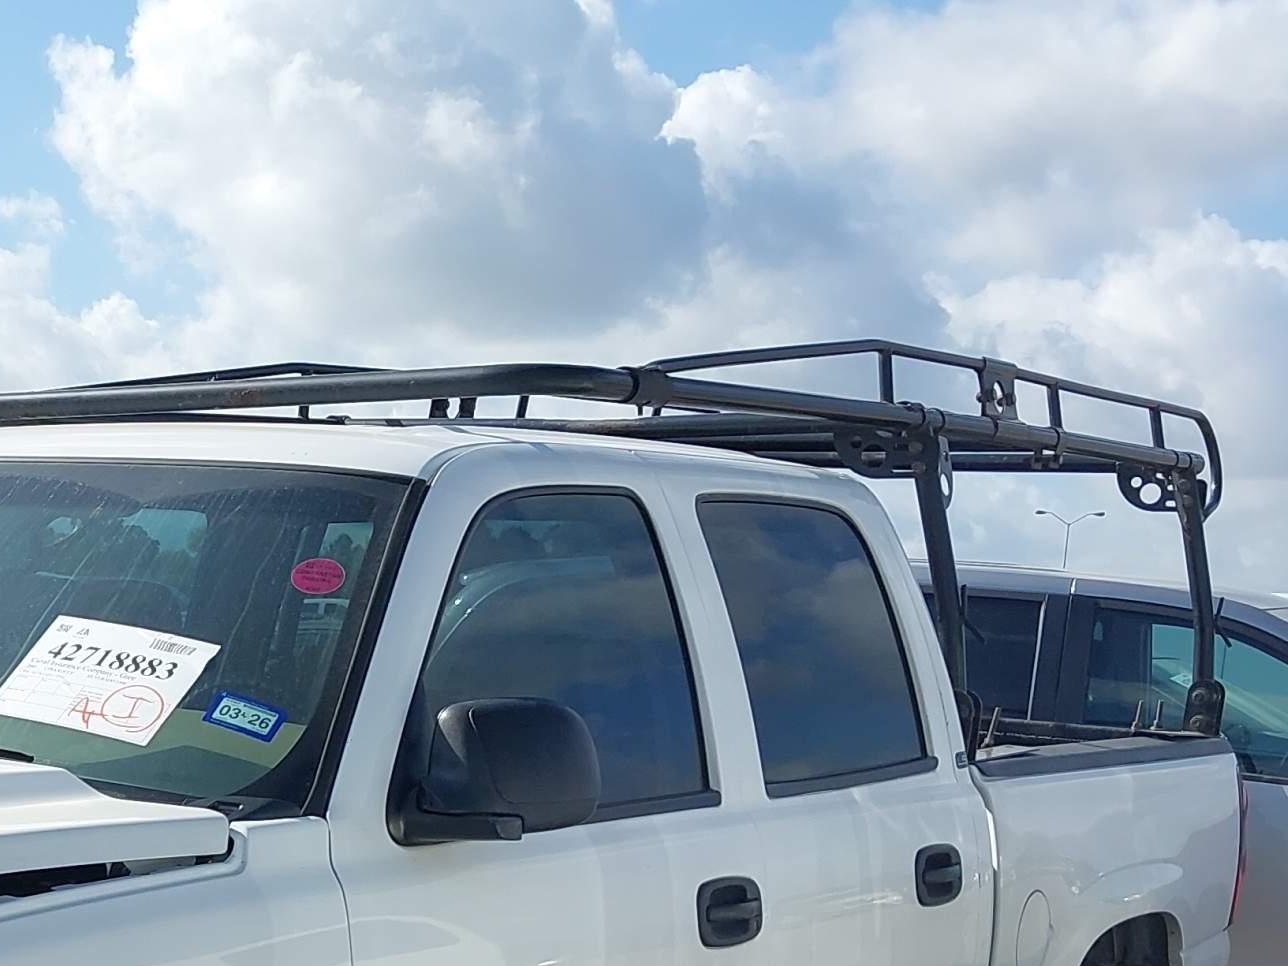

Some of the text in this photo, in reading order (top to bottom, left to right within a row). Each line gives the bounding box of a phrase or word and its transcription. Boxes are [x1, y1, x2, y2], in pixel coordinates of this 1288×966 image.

[48, 641, 178, 680] 42718883
[218, 704, 242, 719] 03
[247, 713, 272, 729] 26
